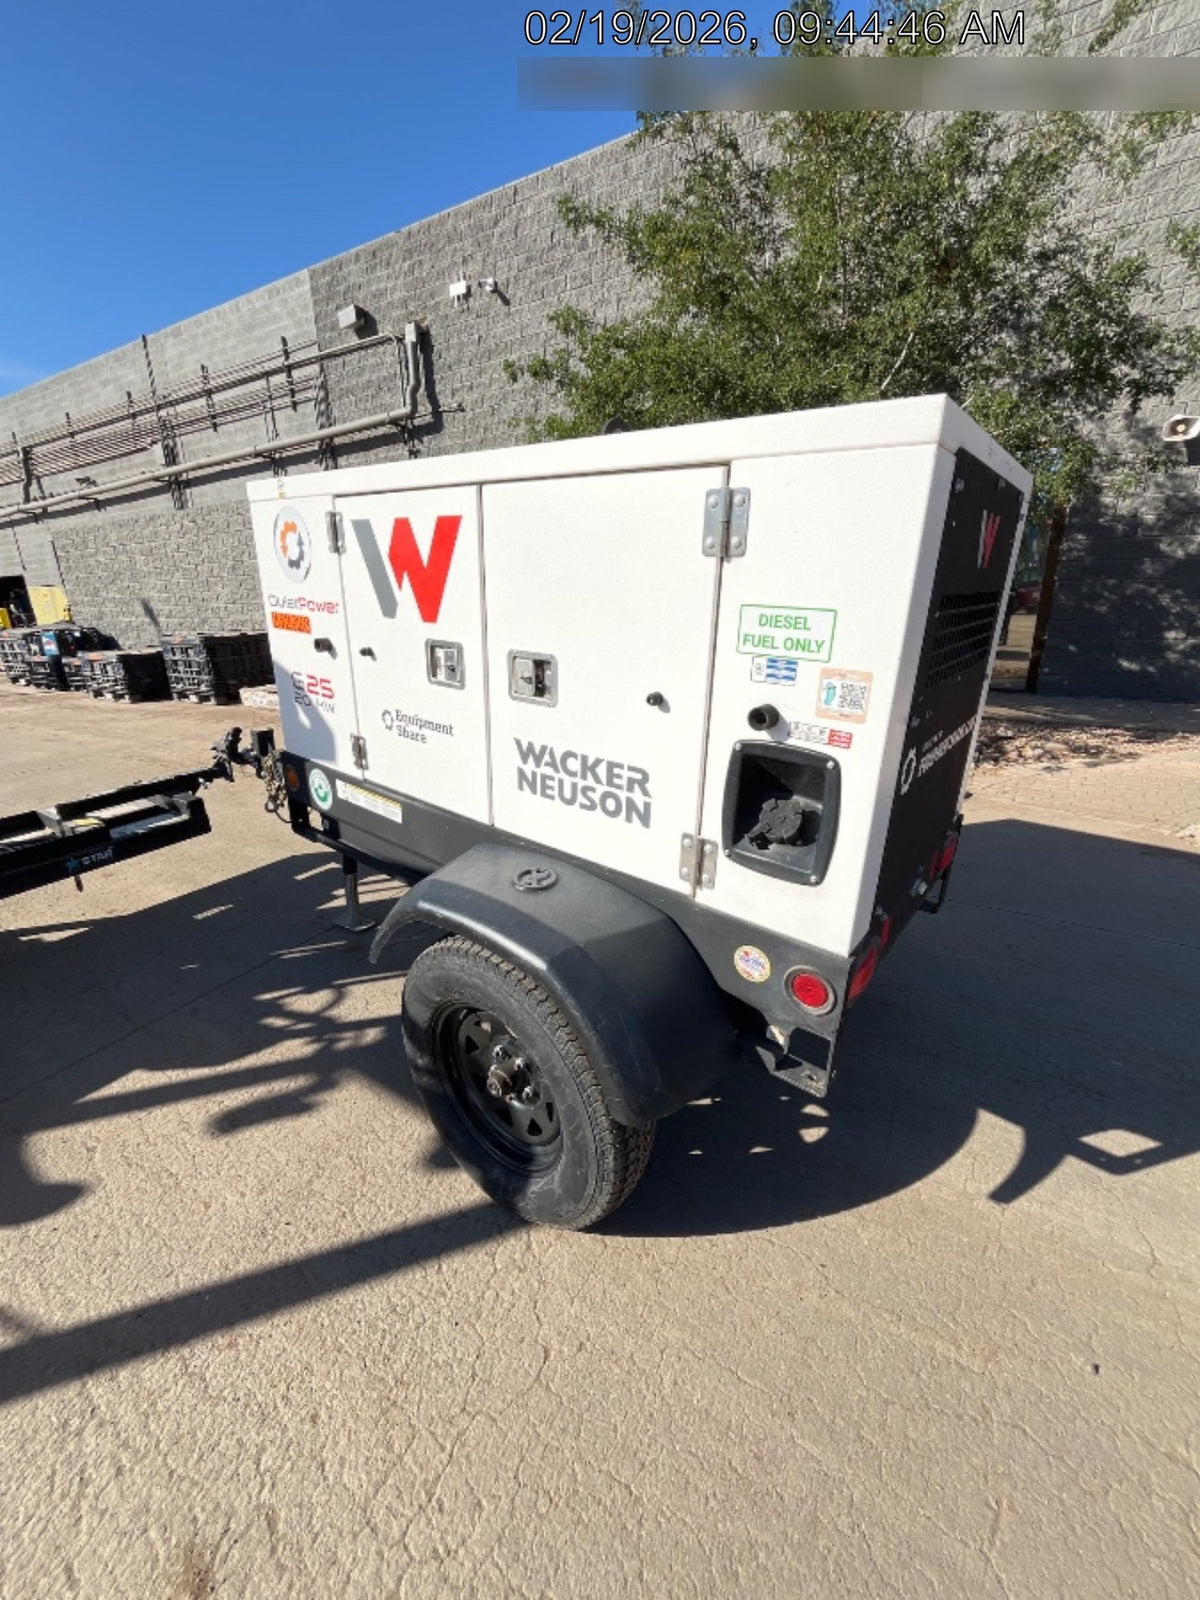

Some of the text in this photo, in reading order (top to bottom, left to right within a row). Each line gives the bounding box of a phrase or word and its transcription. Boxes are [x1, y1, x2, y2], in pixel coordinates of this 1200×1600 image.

[758, 613, 812, 631] DIESEL
[743, 634, 826, 654] FUEL ONLY
[394, 708, 454, 736] Equipment
[395, 725, 428, 743] Share
[513, 737, 653, 799] WACKER
[516, 765, 652, 829] NEUSON
